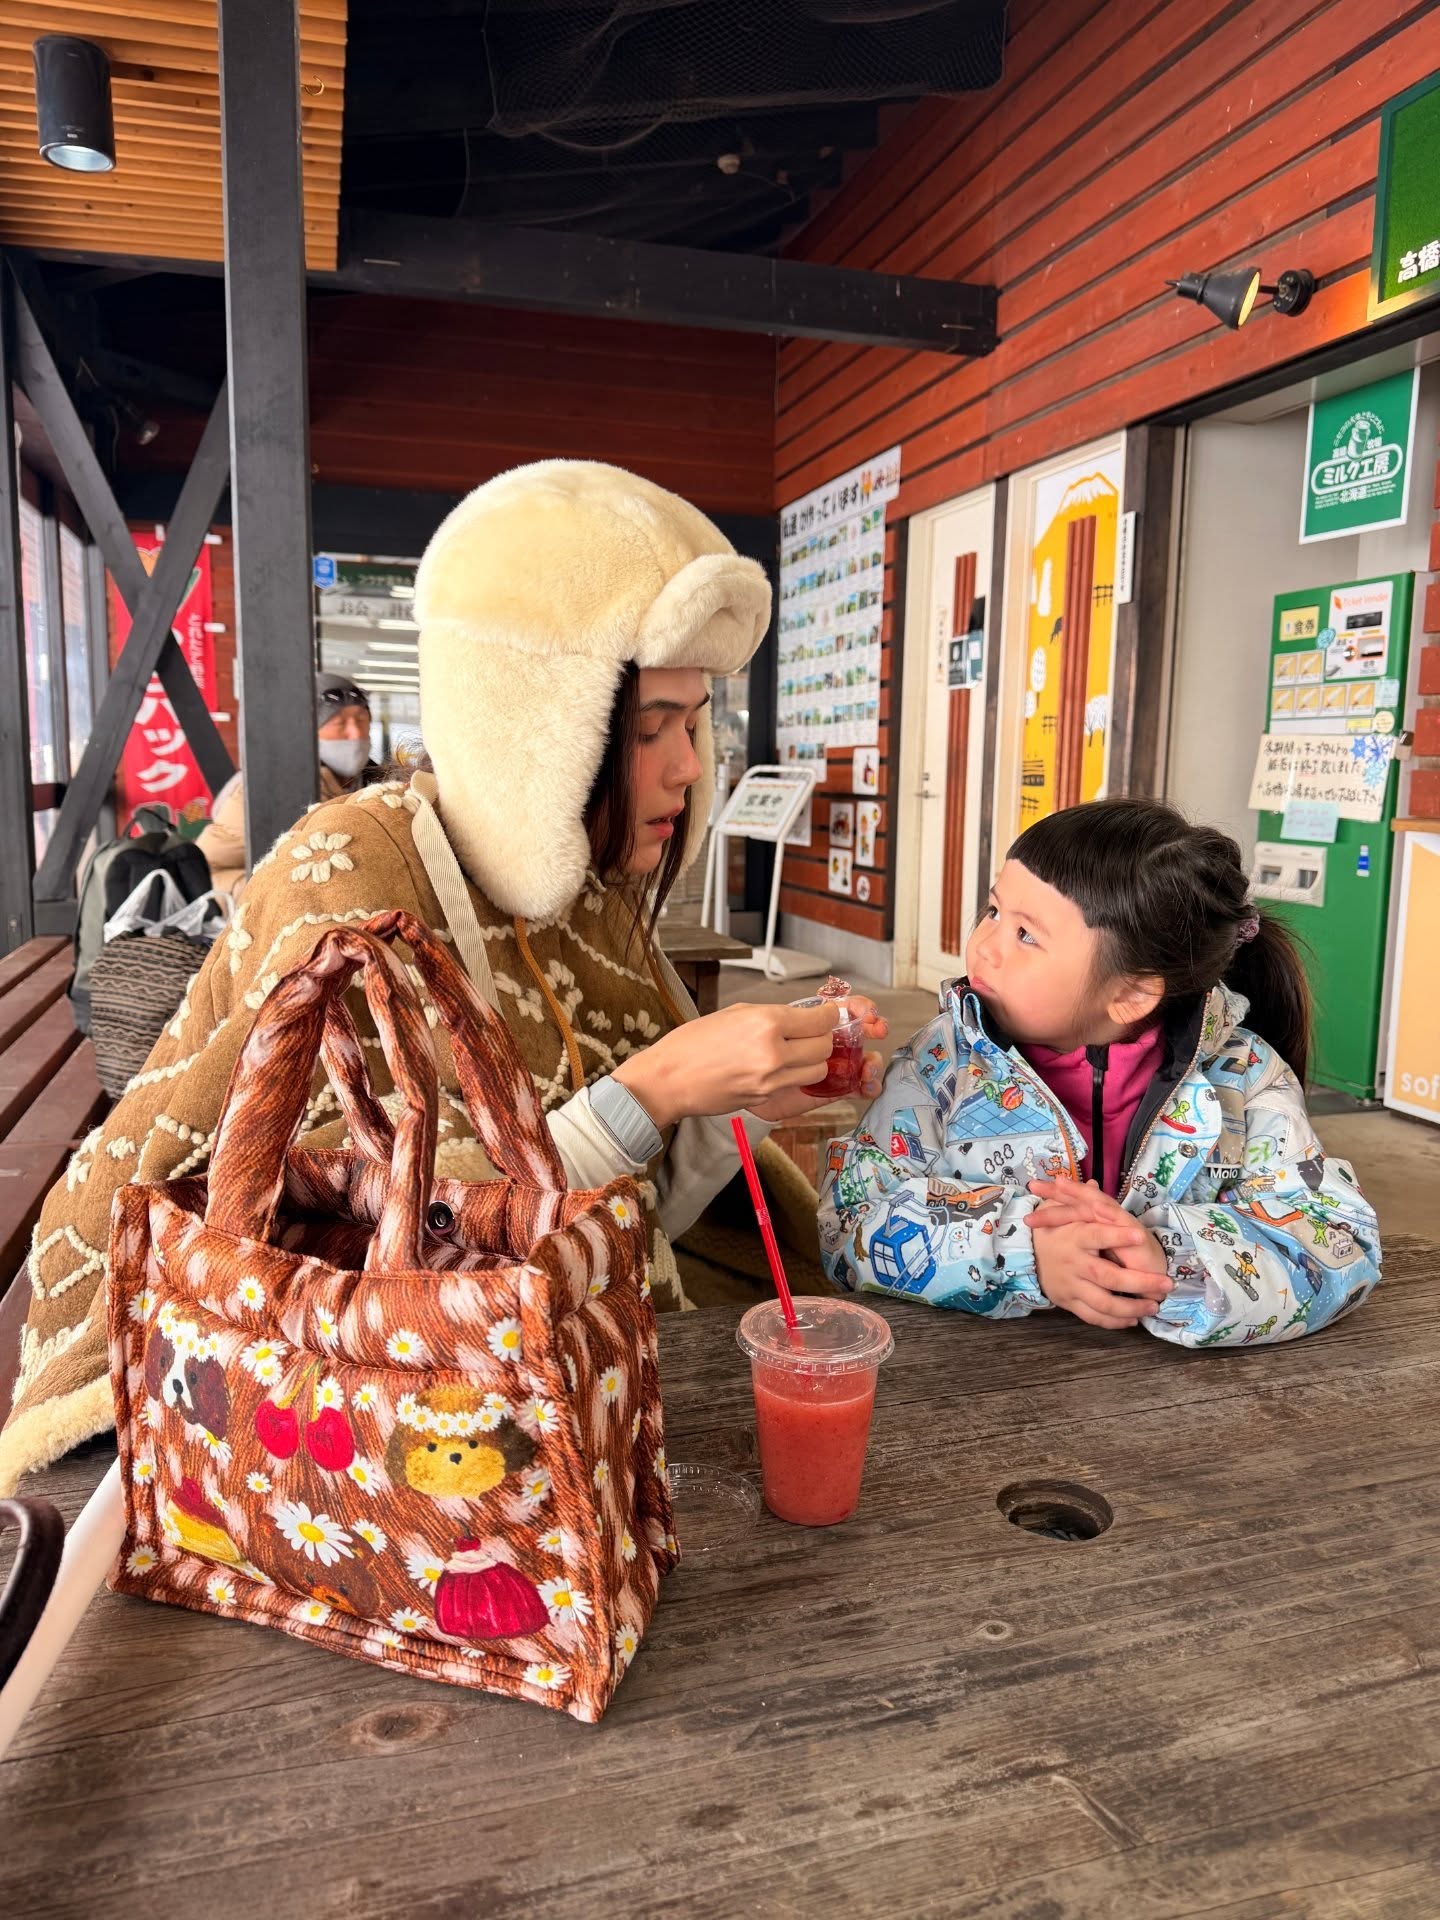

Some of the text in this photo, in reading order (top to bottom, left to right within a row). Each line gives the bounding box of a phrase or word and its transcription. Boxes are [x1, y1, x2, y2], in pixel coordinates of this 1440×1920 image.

[1322, 451, 1391, 485] ミルク工房
[1294, 619, 1315, 635] 食券
